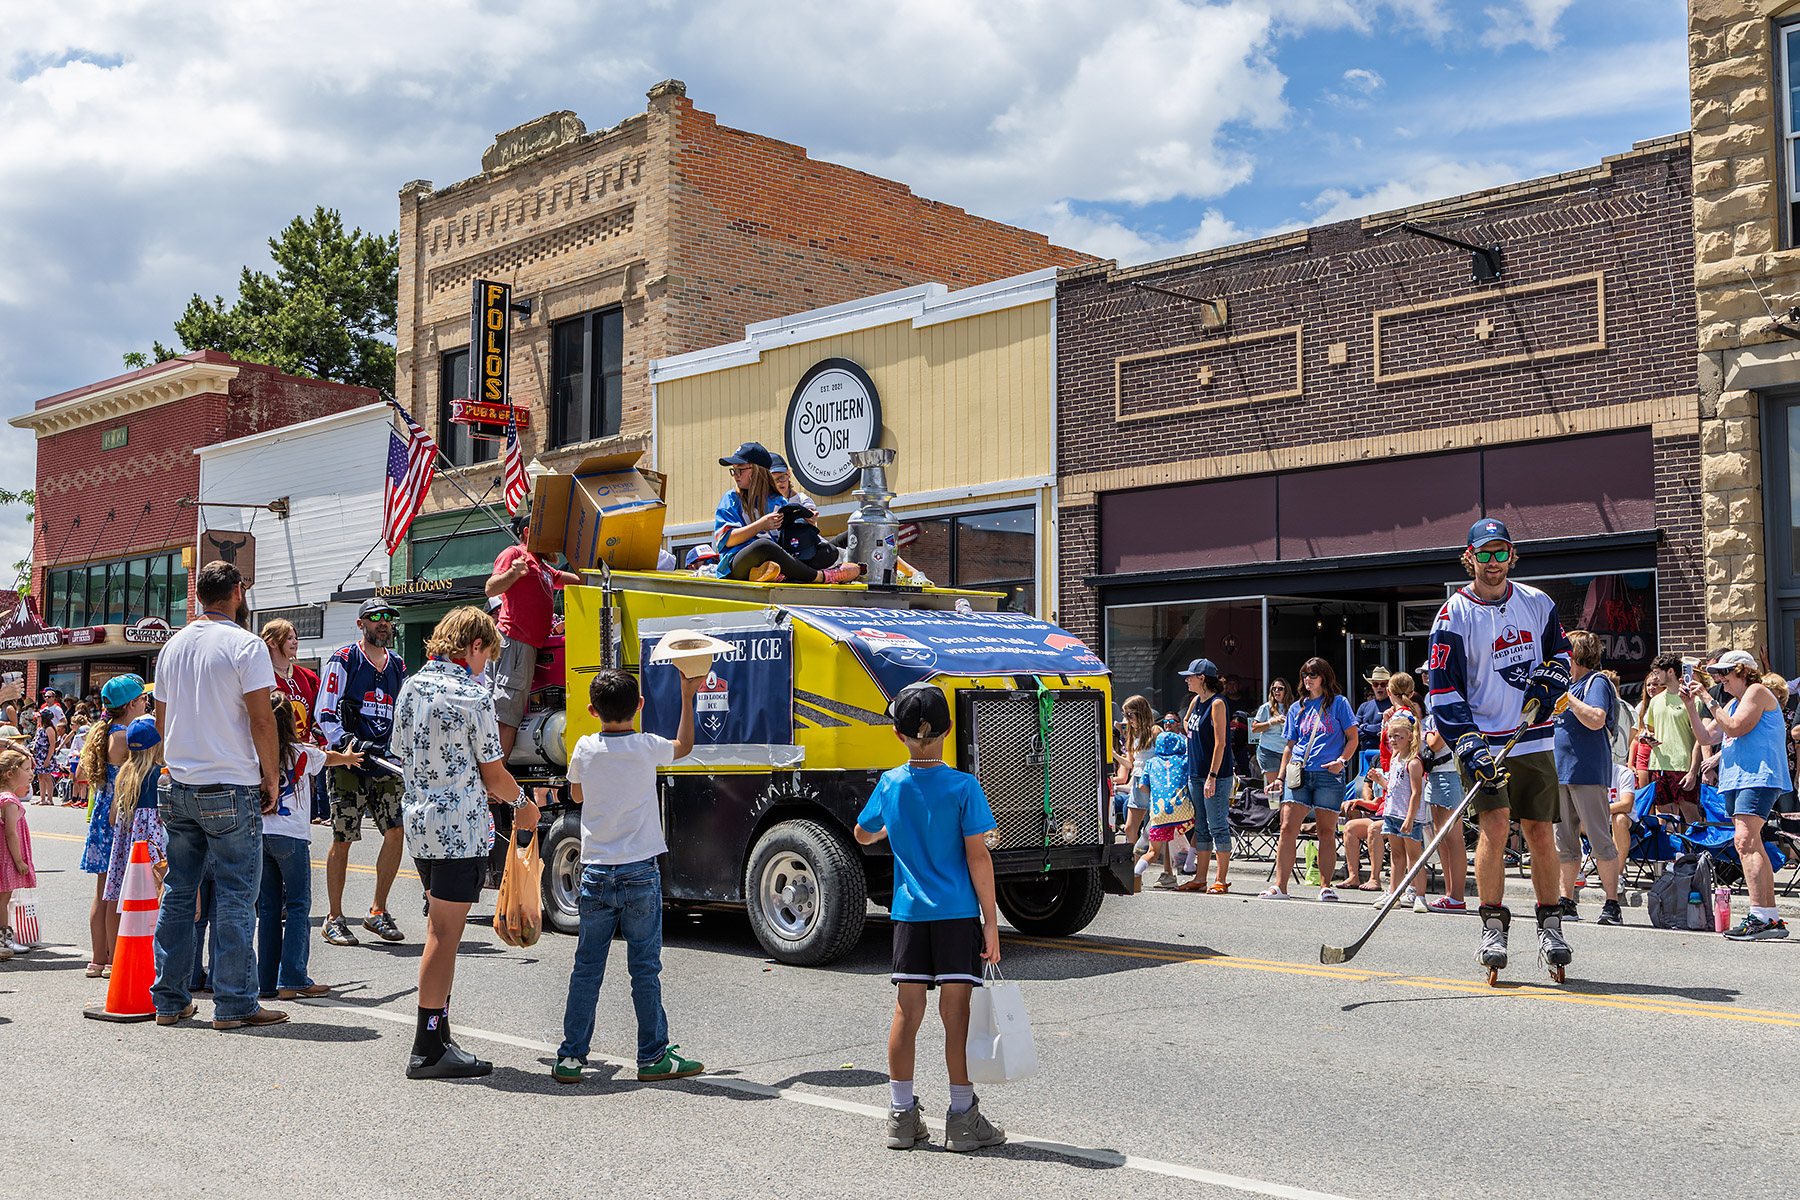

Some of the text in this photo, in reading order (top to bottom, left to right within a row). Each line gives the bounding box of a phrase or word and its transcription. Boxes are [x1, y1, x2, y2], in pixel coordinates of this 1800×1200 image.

[485, 284, 504, 400] FOLOS
[466, 405, 528, 423] PUB & GRLL
[814, 426, 849, 459] DISH
[807, 461, 831, 477] KITCHEN
[375, 583, 407, 597] FOSTER
[408, 583, 414, 593] &
[127, 629, 159, 637] GRIZZLY
[750, 637, 782, 662] ICE
[1430, 643, 1451, 670] 87
[1510, 655, 1523, 663] ICE
